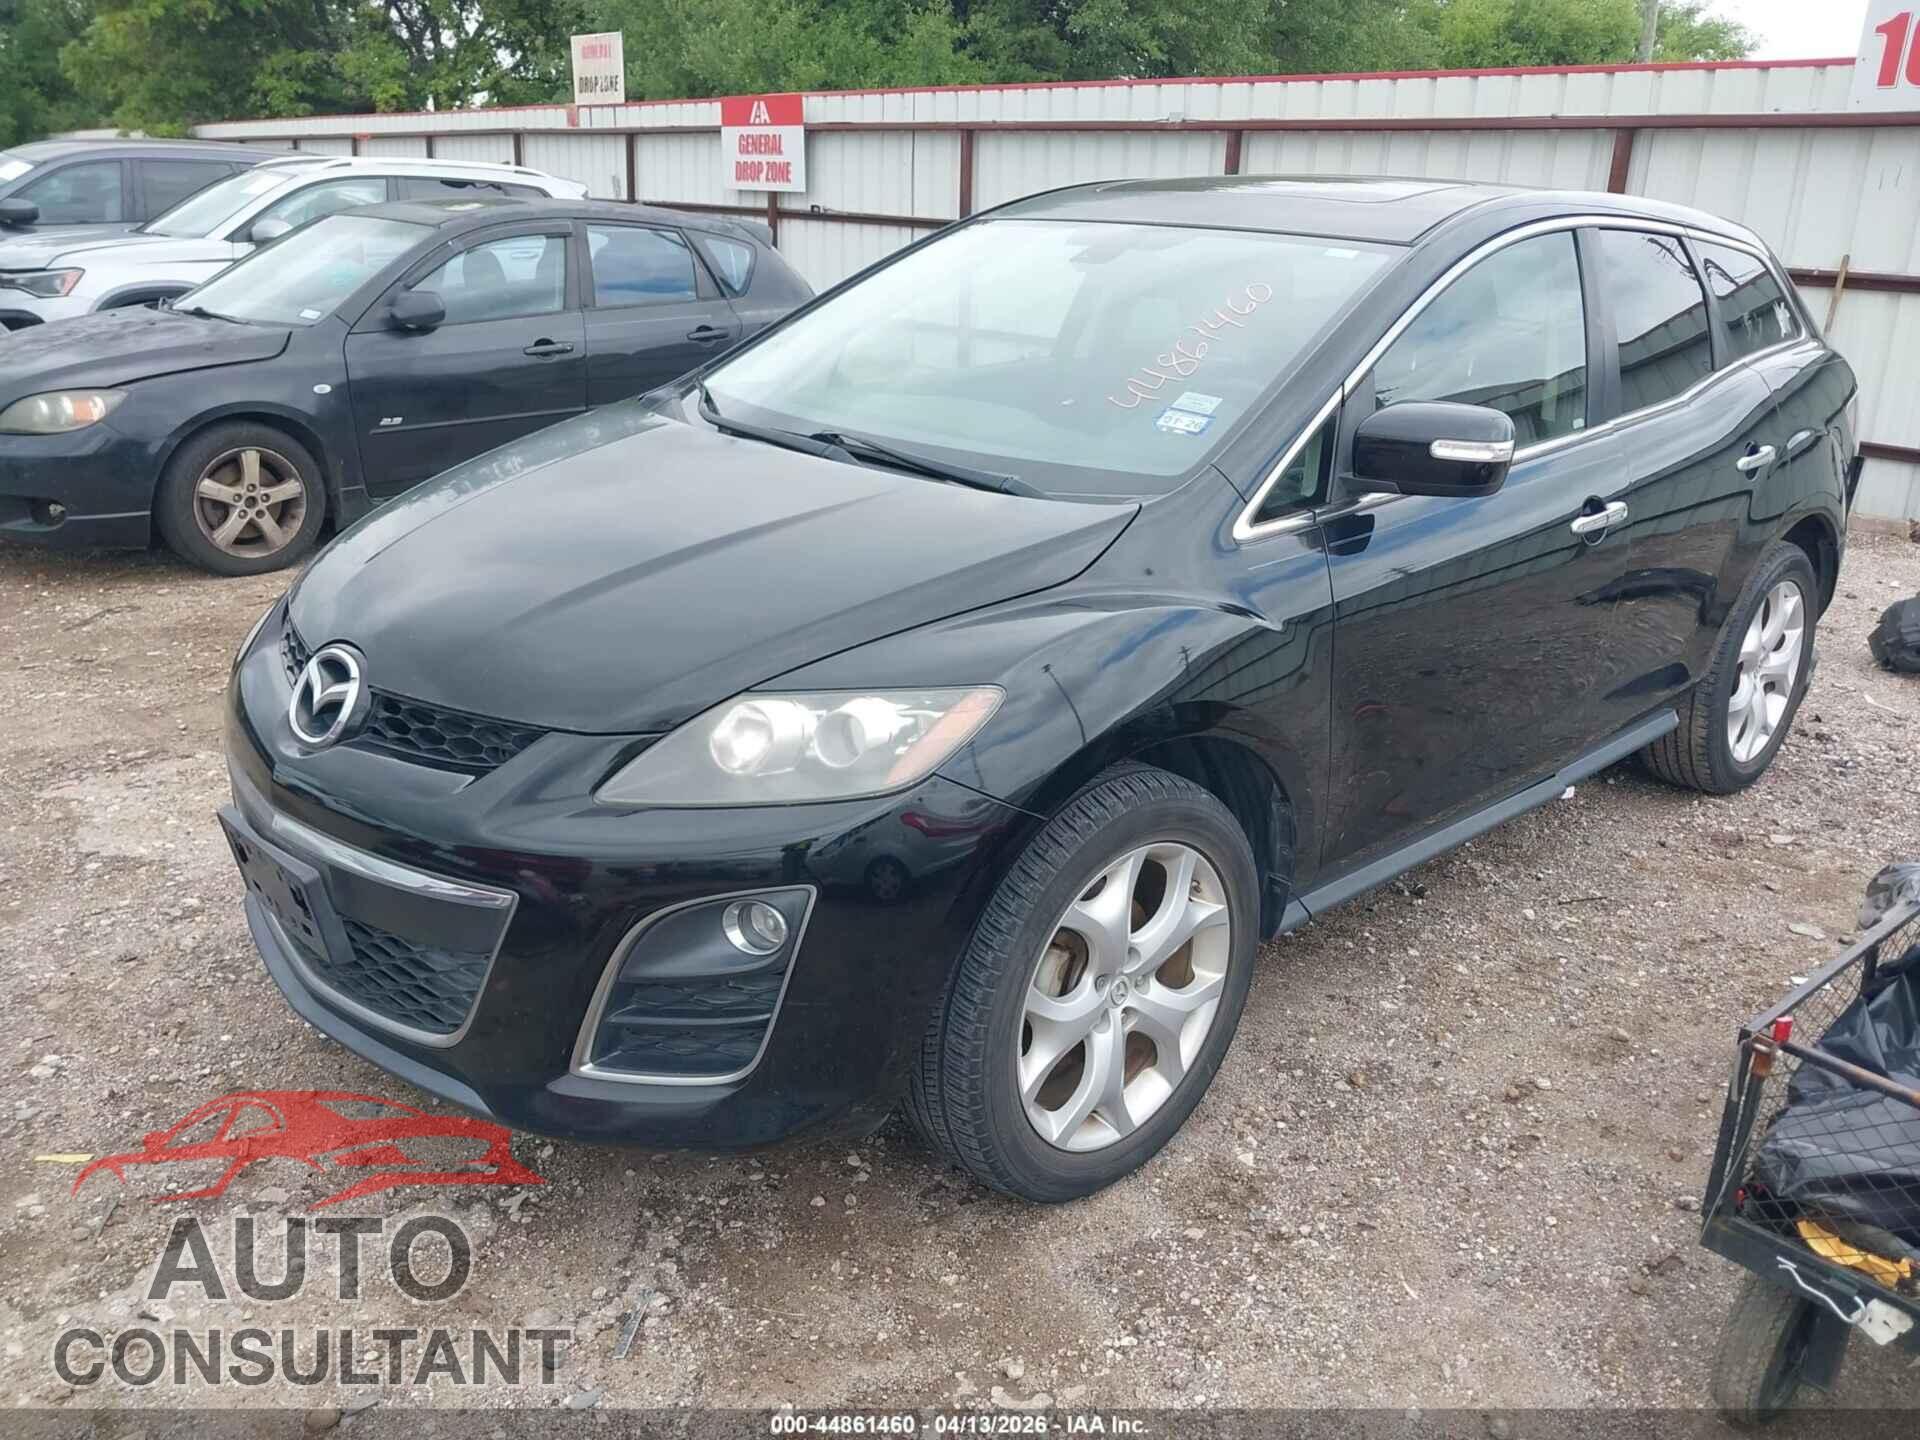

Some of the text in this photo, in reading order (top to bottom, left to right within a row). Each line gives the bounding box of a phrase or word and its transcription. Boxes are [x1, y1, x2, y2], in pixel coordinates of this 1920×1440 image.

[578, 76, 599, 94] DROP
[738, 133, 782, 154] GENERAL
[735, 160, 791, 183] DROP ZONE
[1107, 281, 1273, 408] 44861460
